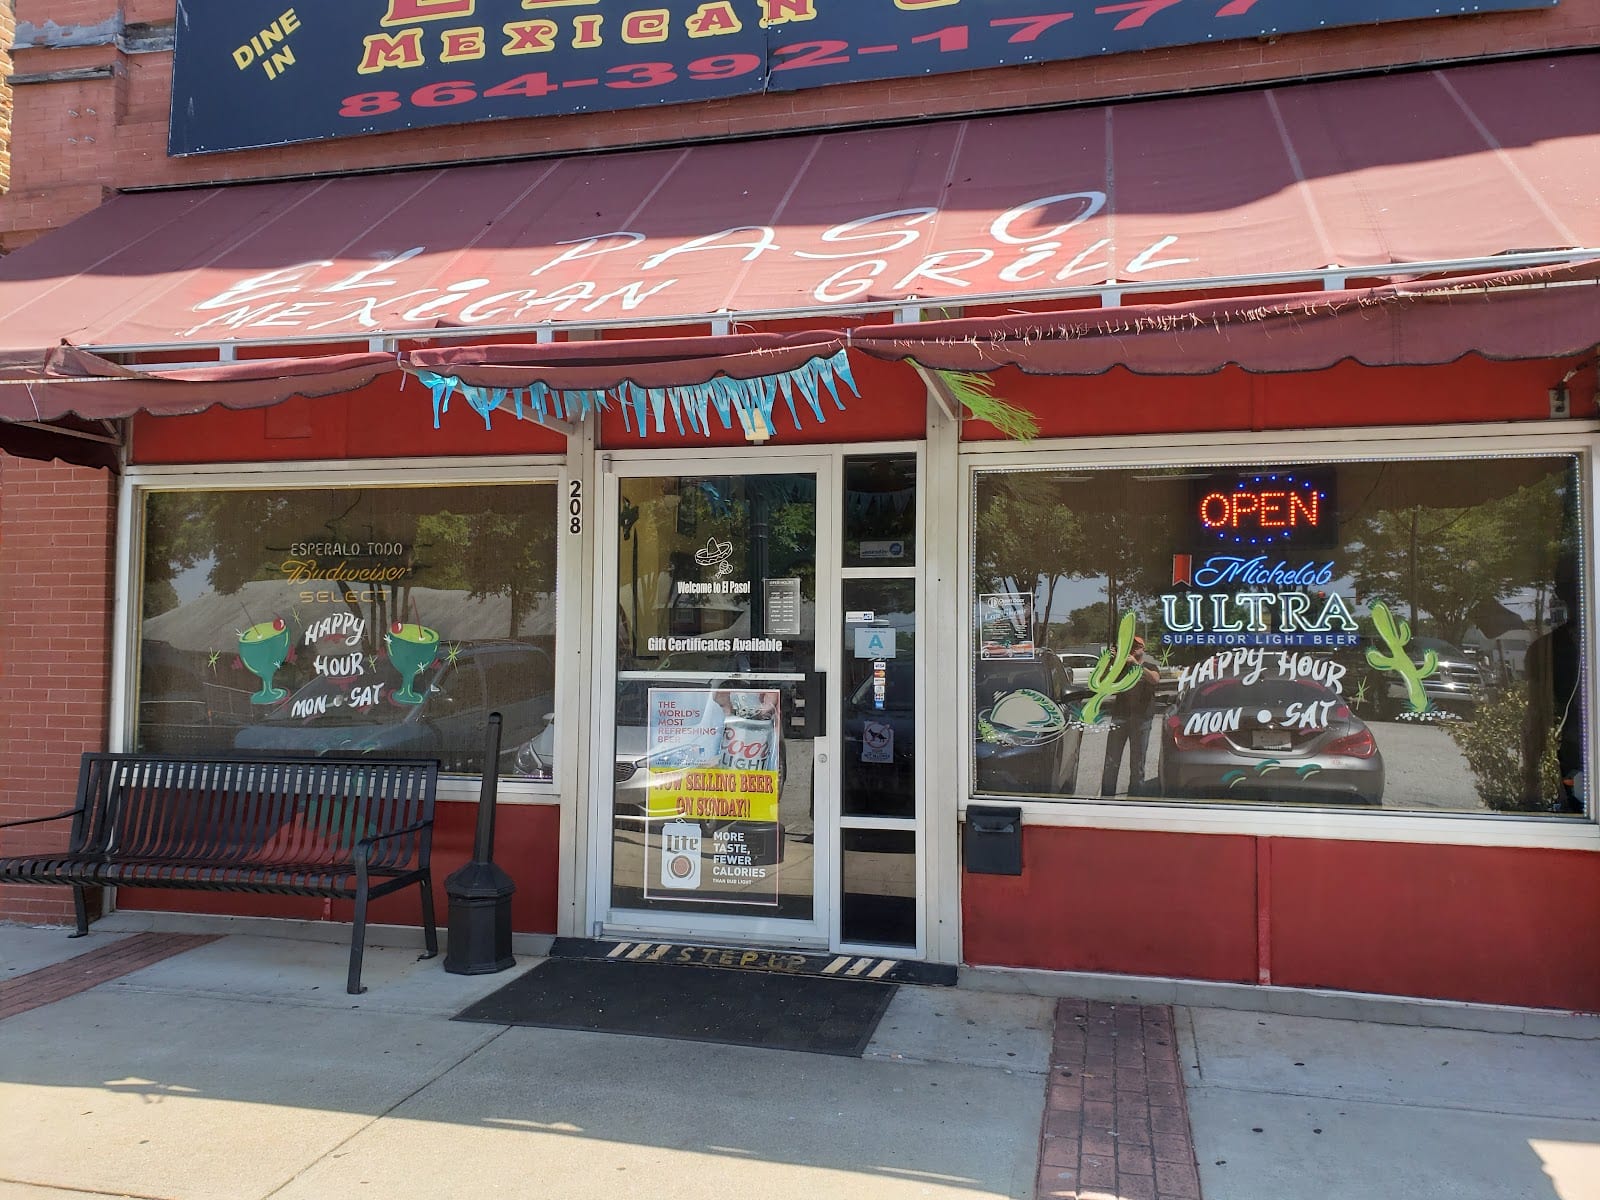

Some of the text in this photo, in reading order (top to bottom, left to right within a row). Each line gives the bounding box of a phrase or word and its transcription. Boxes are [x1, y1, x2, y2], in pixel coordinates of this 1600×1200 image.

[232, 8, 301, 70] DINE
[357, 0, 817, 74] MEXICAN
[262, 45, 296, 80] IN
[193, 191, 1107, 311] EL PASO
[569, 479, 582, 535] 208
[1200, 491, 1318, 528] OPEN
[290, 542, 403, 557] ESPERALO TODO
[280, 559, 414, 585] Budweiser
[1194, 555, 1335, 587] Michelob
[299, 590, 392, 603] SELECT
[677, 580, 751, 594] Welcome to El Paso!
[1161, 591, 1359, 633] ULTRA
[304, 611, 365, 646] HAPPY
[1162, 633, 1358, 645] SUPERIOR LIGHT BEER
[647, 637, 783, 652] Gift Certificates Available
[867, 635, 884, 649] A
[313, 651, 365, 676] HOUR
[1177, 647, 1347, 695] HAPPY HOUR
[291, 682, 385, 719] MON SAT
[658, 701, 676, 709] THE
[658, 709, 701, 718] WORLD'S
[658, 718, 685, 726] MOST
[1183, 700, 1337, 736] MON SAT
[658, 727, 717, 736] REFRESHING
[721, 752, 768, 771] LIGHT
[686, 772, 737, 793] SELLING
[740, 774, 774, 794] BEER
[676, 796, 693, 816] ON
[713, 831, 745, 842] MORE
[713, 843, 751, 855] TASTE,
[713, 854, 752, 866] FEWER
[712, 866, 766, 878] CALORIES
[676, 947, 806, 971] STEP UP
